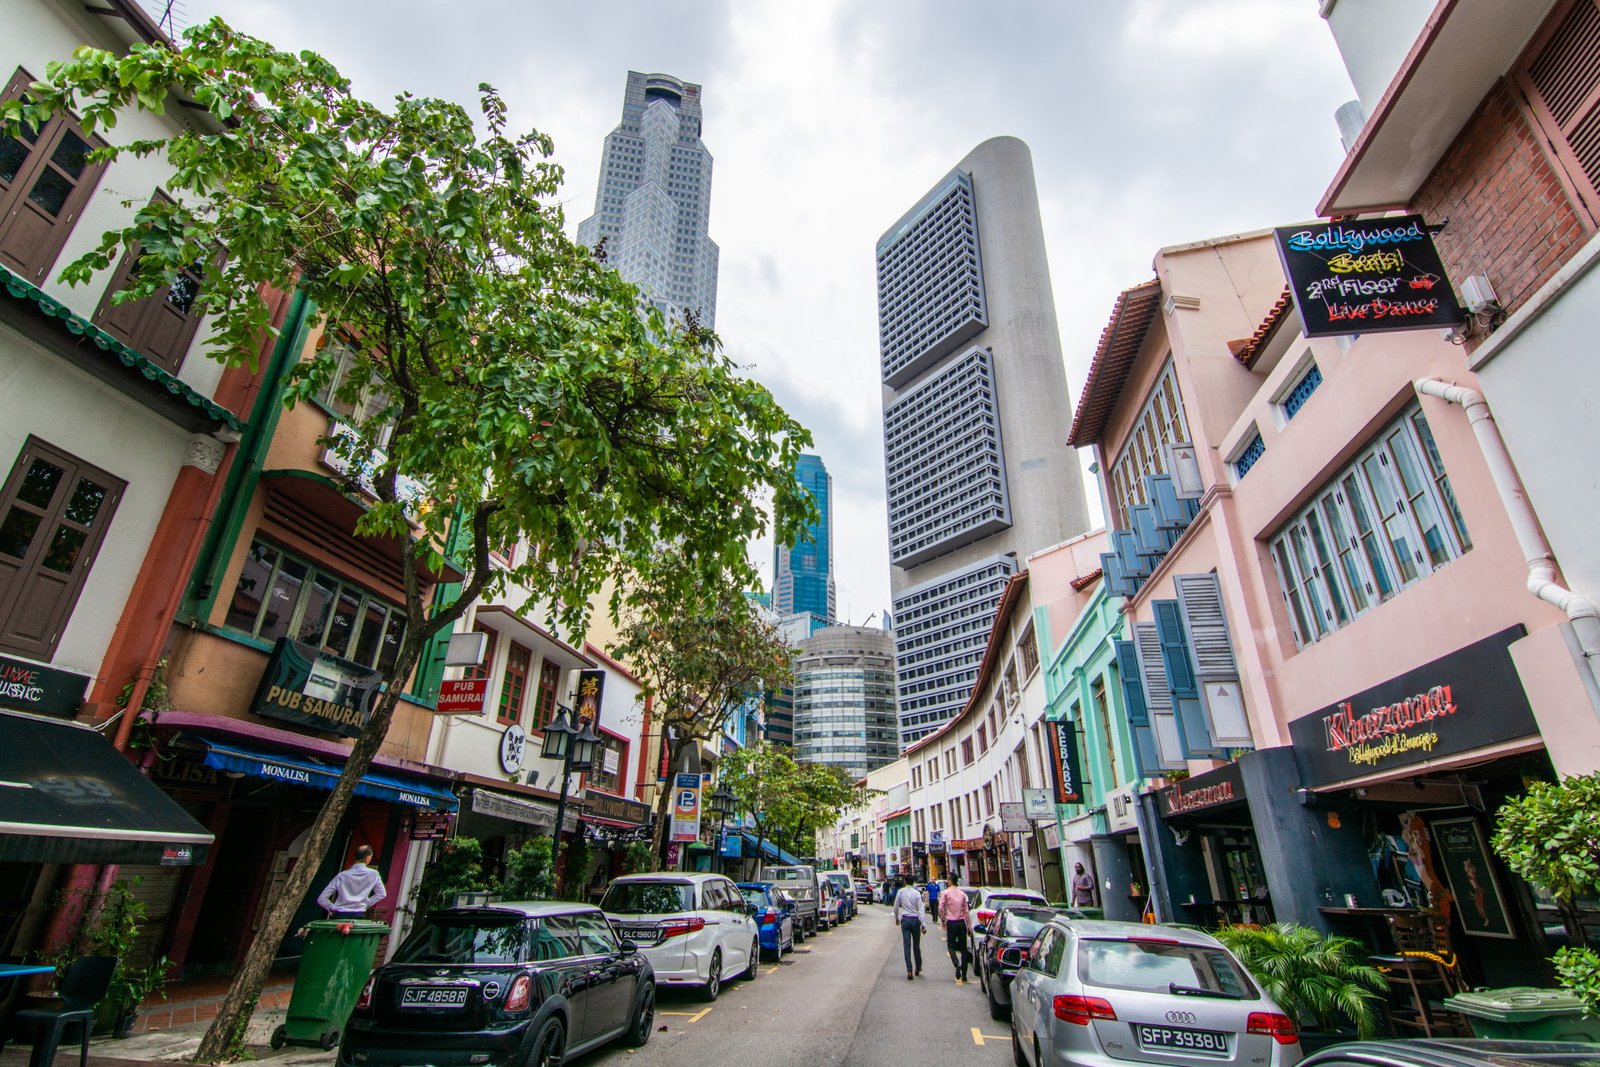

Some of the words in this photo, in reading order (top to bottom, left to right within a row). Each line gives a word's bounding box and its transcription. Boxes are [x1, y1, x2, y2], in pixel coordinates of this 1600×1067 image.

[1288, 221, 1426, 254] Bollywood
[1327, 249, 1405, 274] Beats!
[1328, 299, 1370, 321] Live
[1368, 297, 1440, 319] Dance
[0, 680, 44, 702] USIC
[438, 692, 485, 704] SAMURAI
[453, 681, 475, 692] PUB
[266, 685, 302, 710] PUB
[303, 696, 366, 728] SAMURAI
[1322, 684, 1458, 753] Khazana
[1057, 724, 1074, 795] KEBABS
[261, 763, 310, 783] MONALISA
[399, 792, 430, 806] MONALISA
[1165, 781, 1236, 814] Khazana
